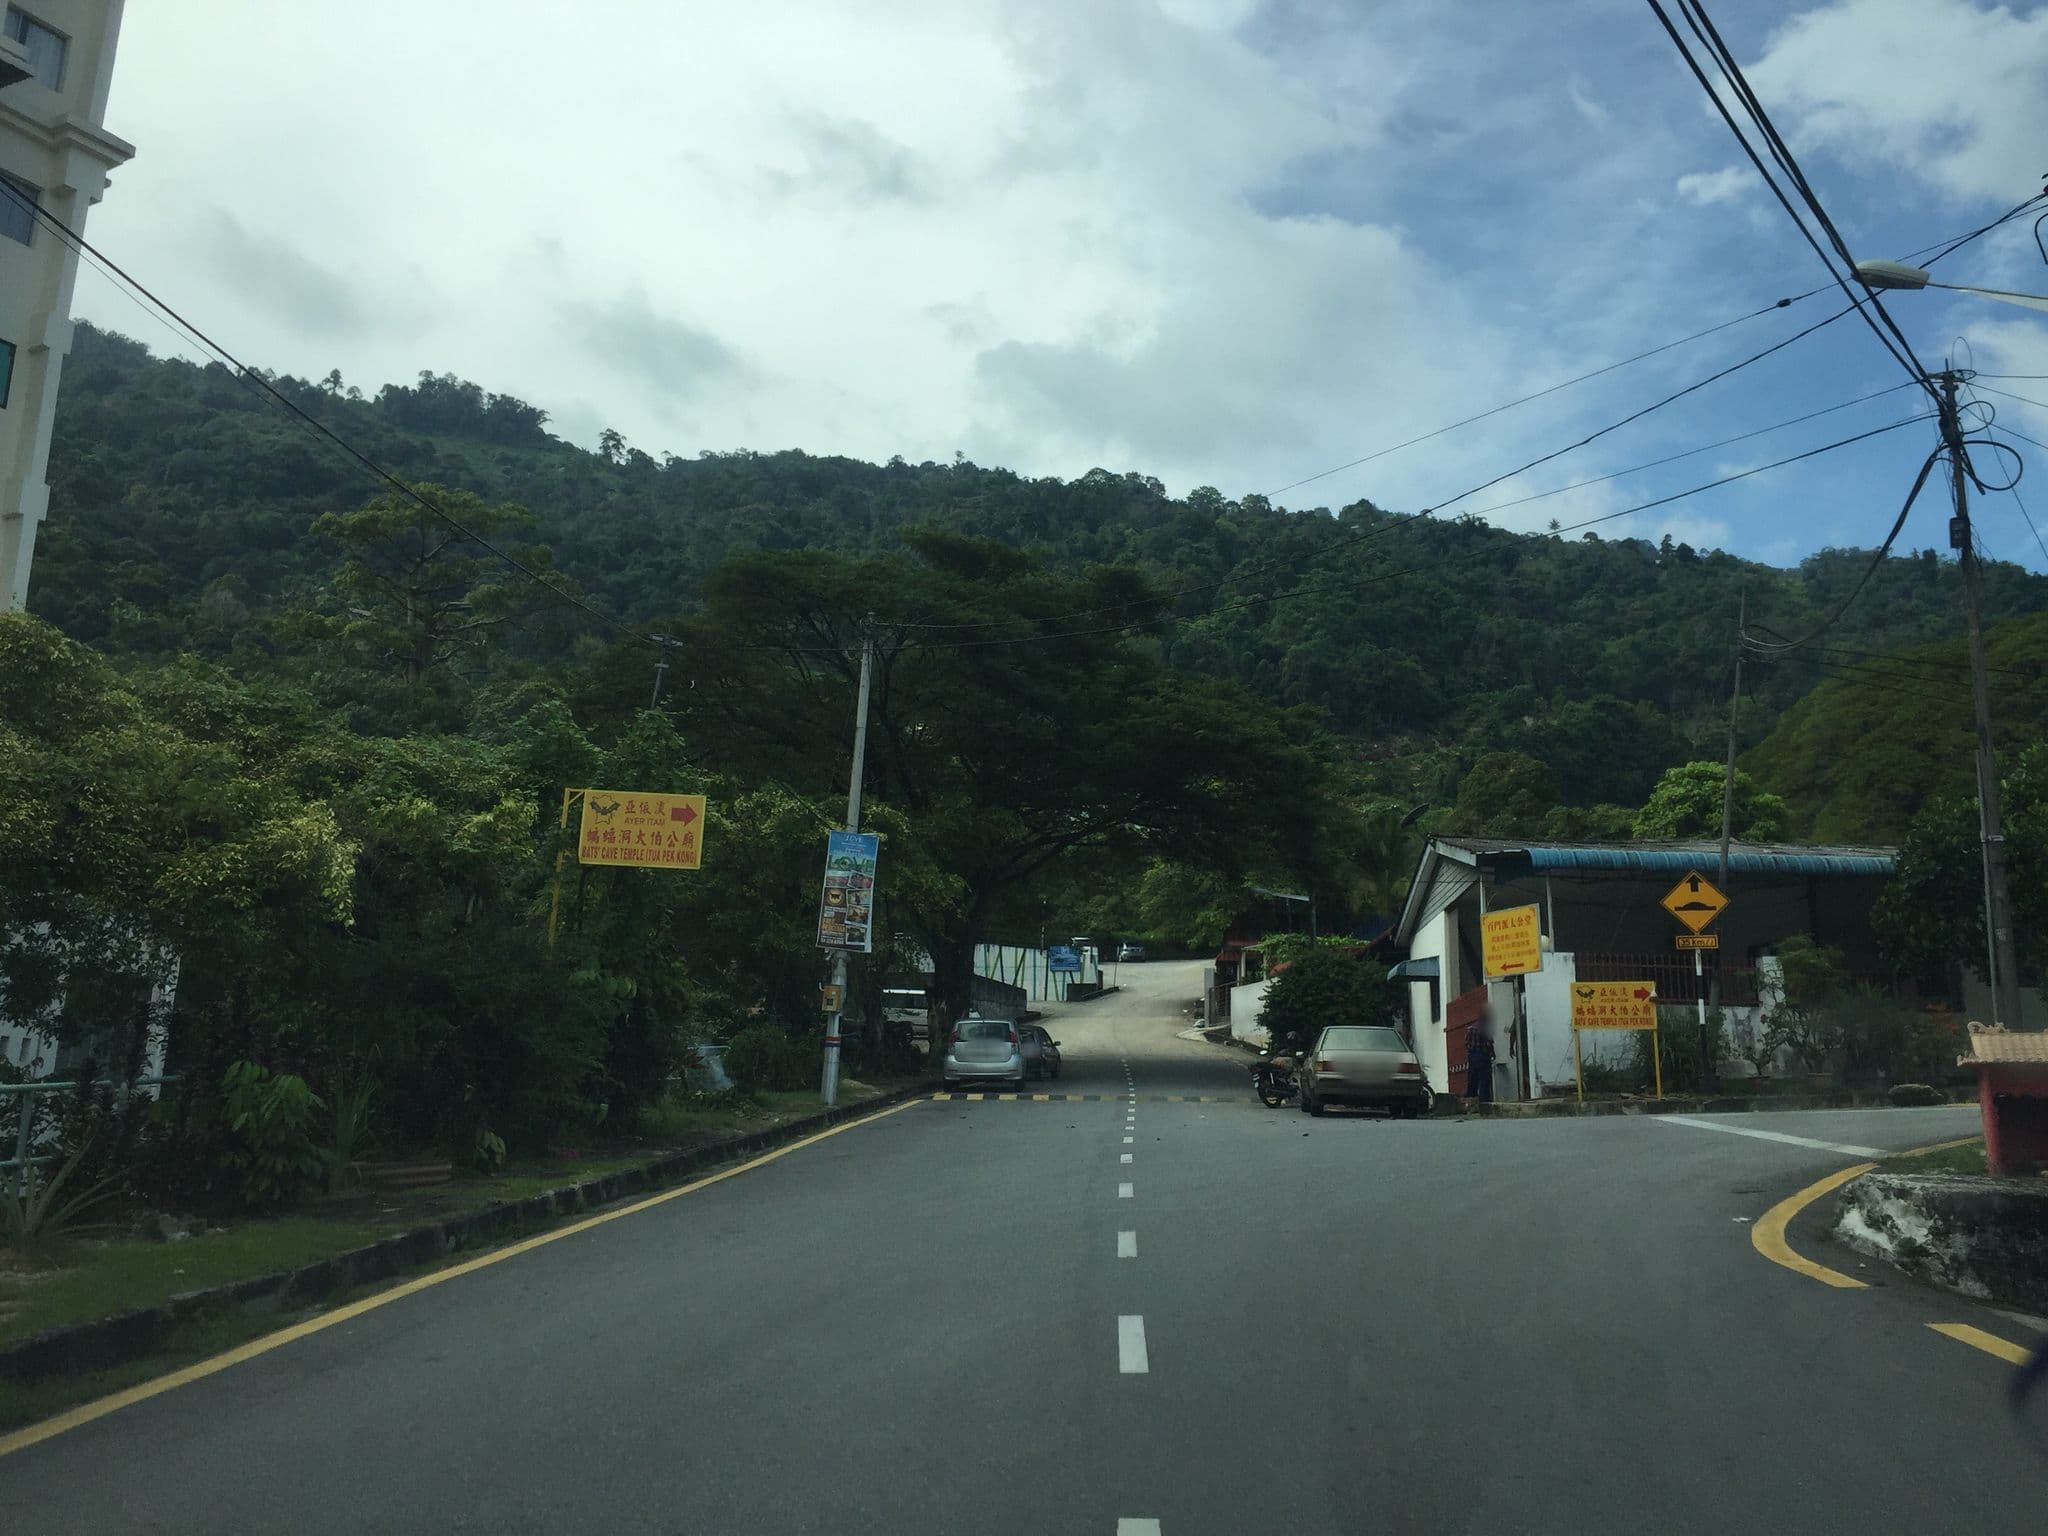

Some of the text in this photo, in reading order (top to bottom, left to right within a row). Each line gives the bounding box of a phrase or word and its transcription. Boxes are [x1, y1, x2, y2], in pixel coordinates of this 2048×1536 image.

[624, 817, 666, 827] AYER ITAM
[601, 847, 619, 860] CAVE
[620, 848, 645, 862] TEMPLE
[662, 849, 675, 863] PEK
